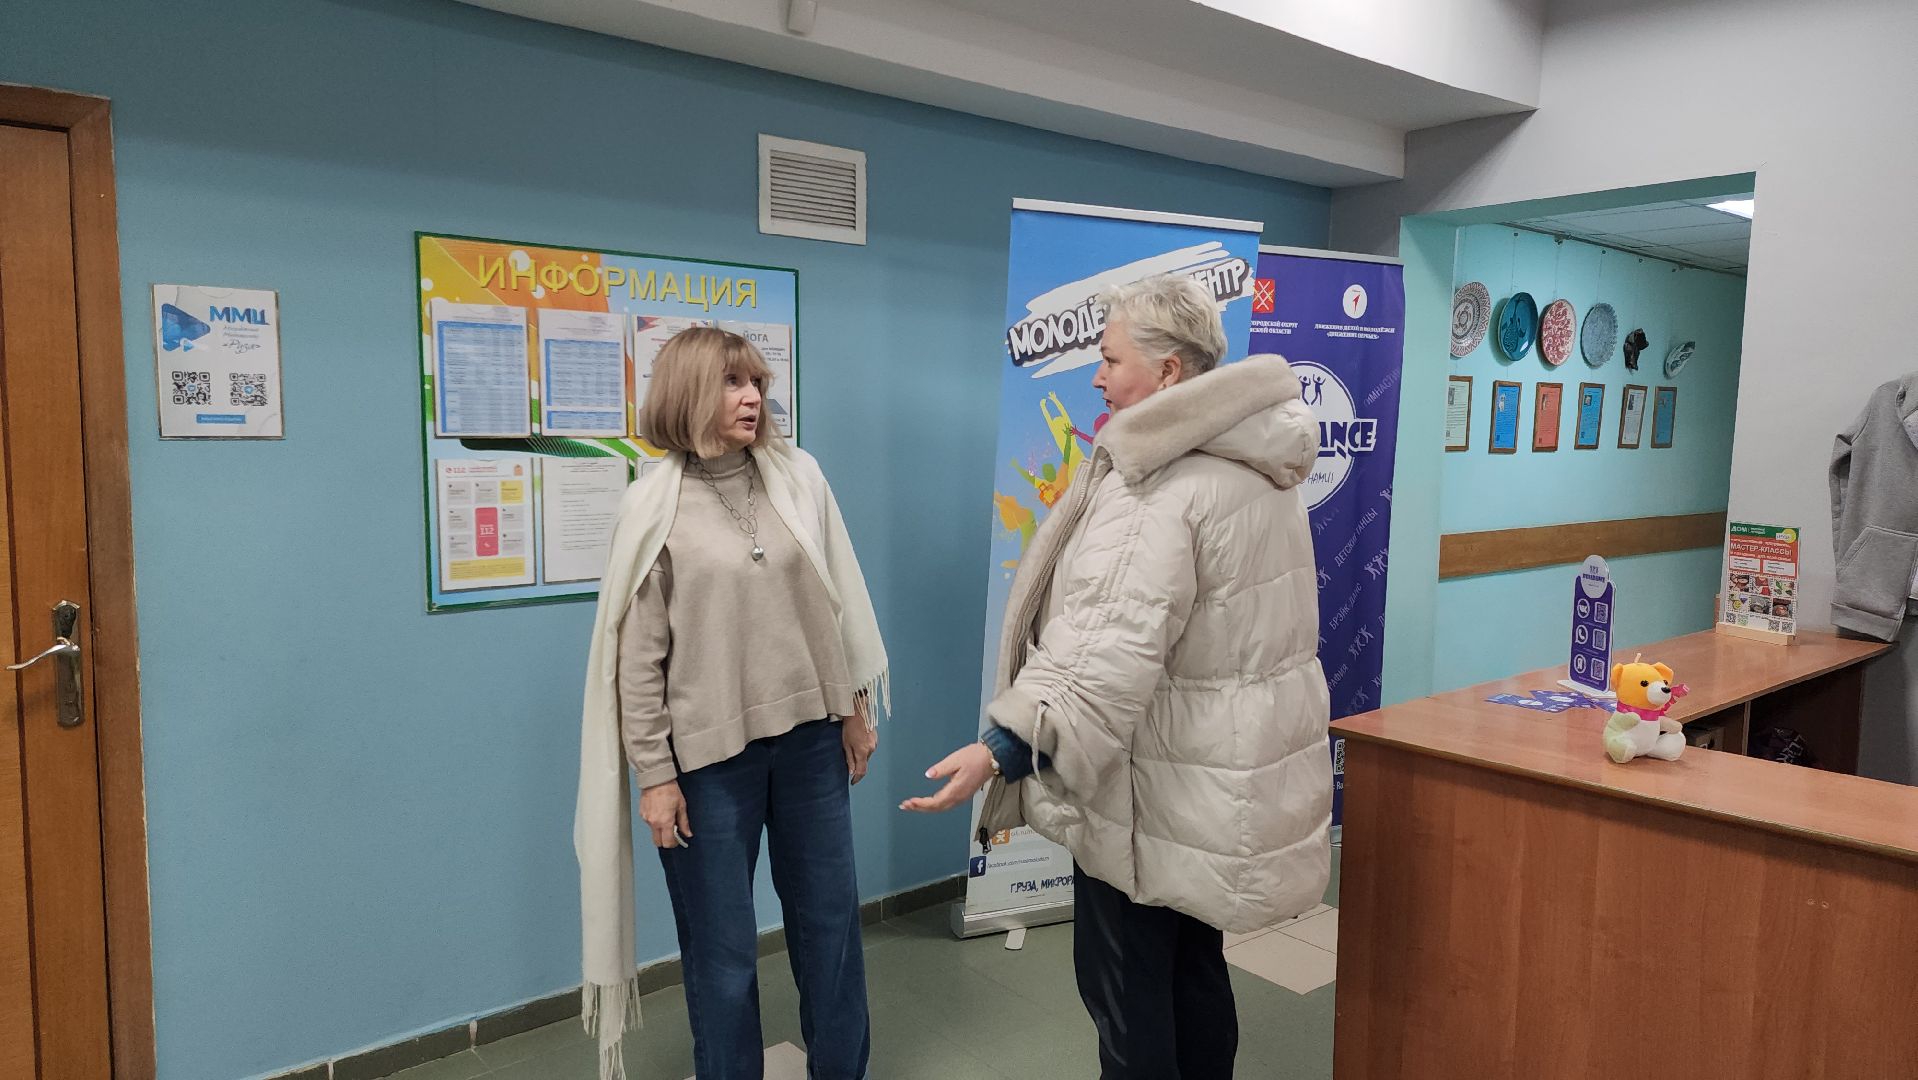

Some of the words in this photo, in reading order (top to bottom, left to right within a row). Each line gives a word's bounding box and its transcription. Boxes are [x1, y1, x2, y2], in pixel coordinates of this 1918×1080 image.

[478, 255, 757, 311] ИНФОРМАЦИЯ
[210, 306, 270, 325] ММЦ
[1008, 297, 1107, 361] МОЛОДЁ
[1356, 507, 1378, 534] ТАНЦЫ
[1730, 543, 1792, 556] МАСТЕР-КЛАССЫ
